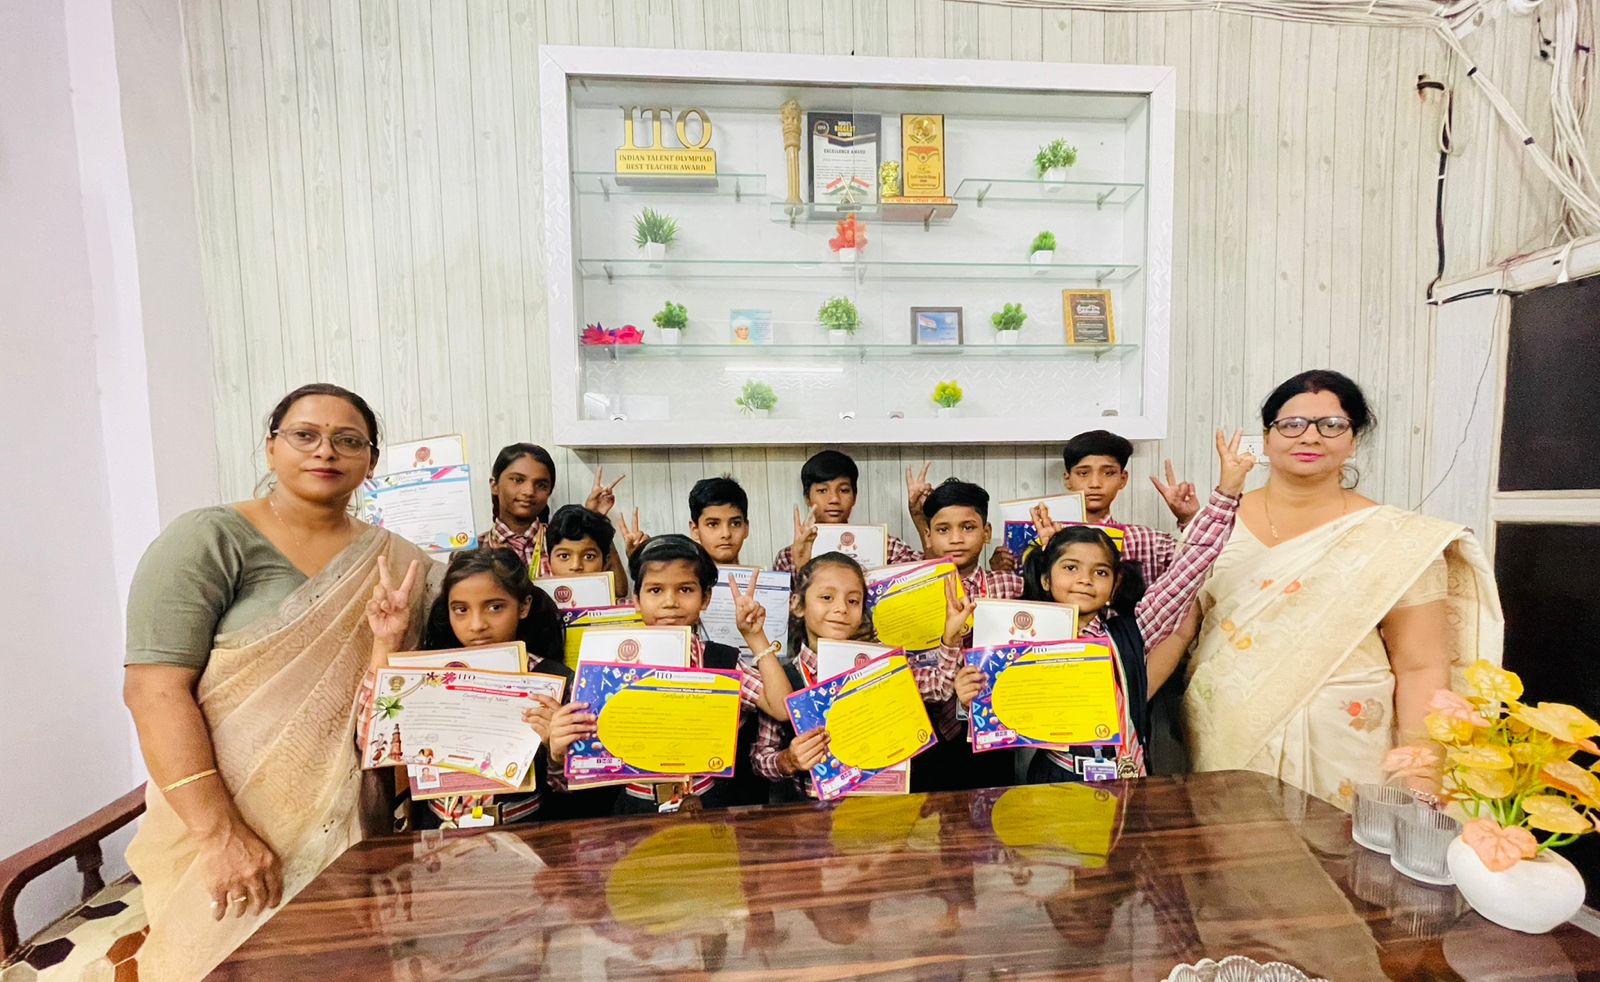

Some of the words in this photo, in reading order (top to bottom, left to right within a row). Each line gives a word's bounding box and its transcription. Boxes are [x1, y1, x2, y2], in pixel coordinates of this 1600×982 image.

[619, 105, 712, 149] ITO
[656, 671, 672, 680] ITO
[851, 672, 863, 681] ITO
[462, 693, 487, 701] Certificate
